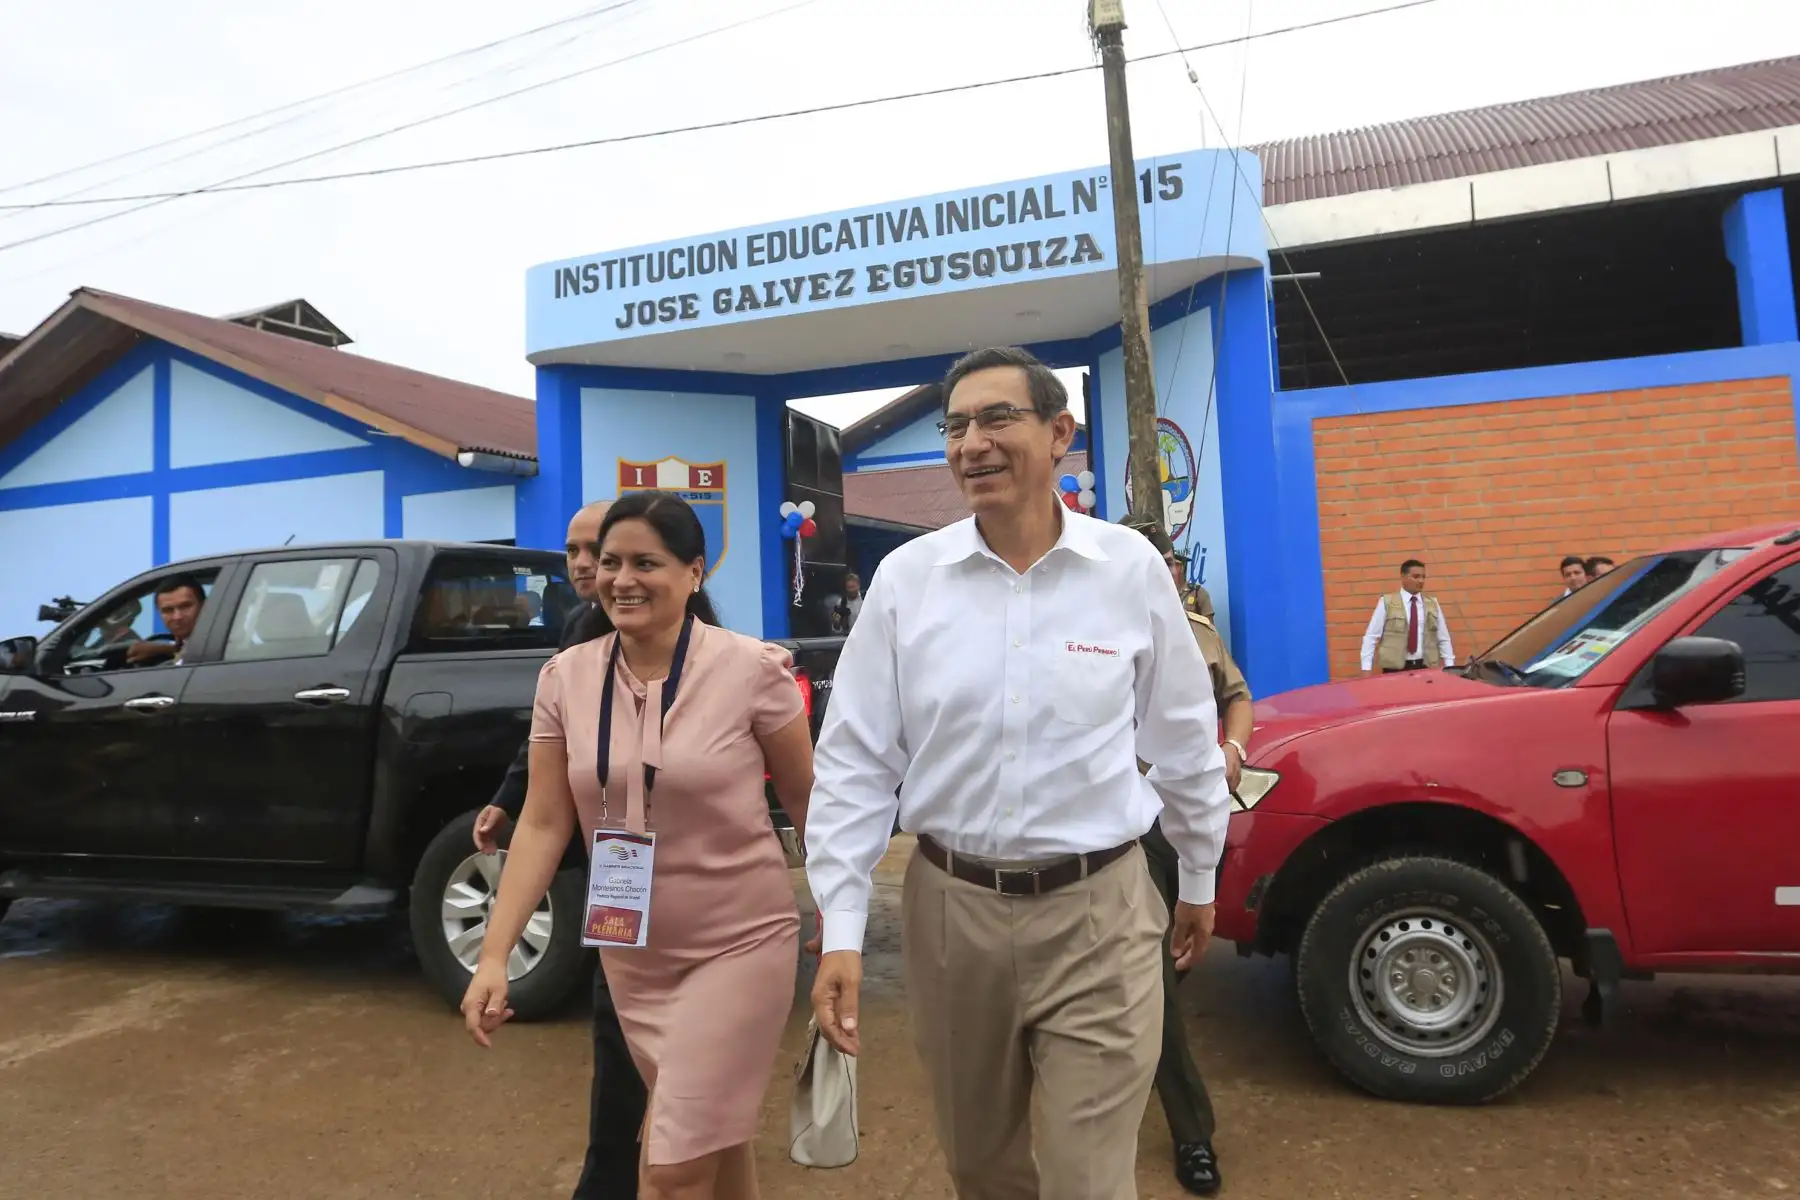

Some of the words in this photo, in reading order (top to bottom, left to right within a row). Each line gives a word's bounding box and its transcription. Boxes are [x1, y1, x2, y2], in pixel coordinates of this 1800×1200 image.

[554, 237, 738, 299] INSTITUCION
[746, 206, 929, 268] EDUCATIVA
[935, 183, 1066, 237] INICIAL
[1139, 163, 1184, 204] 15
[615, 293, 700, 330] JOSE
[712, 267, 856, 315] GALVEZ
[866, 232, 1104, 294] EGUSQUIZA
[697, 469, 712, 486] E
[603, 915, 625, 927] SALA
[591, 923, 633, 938] PLENARIA
